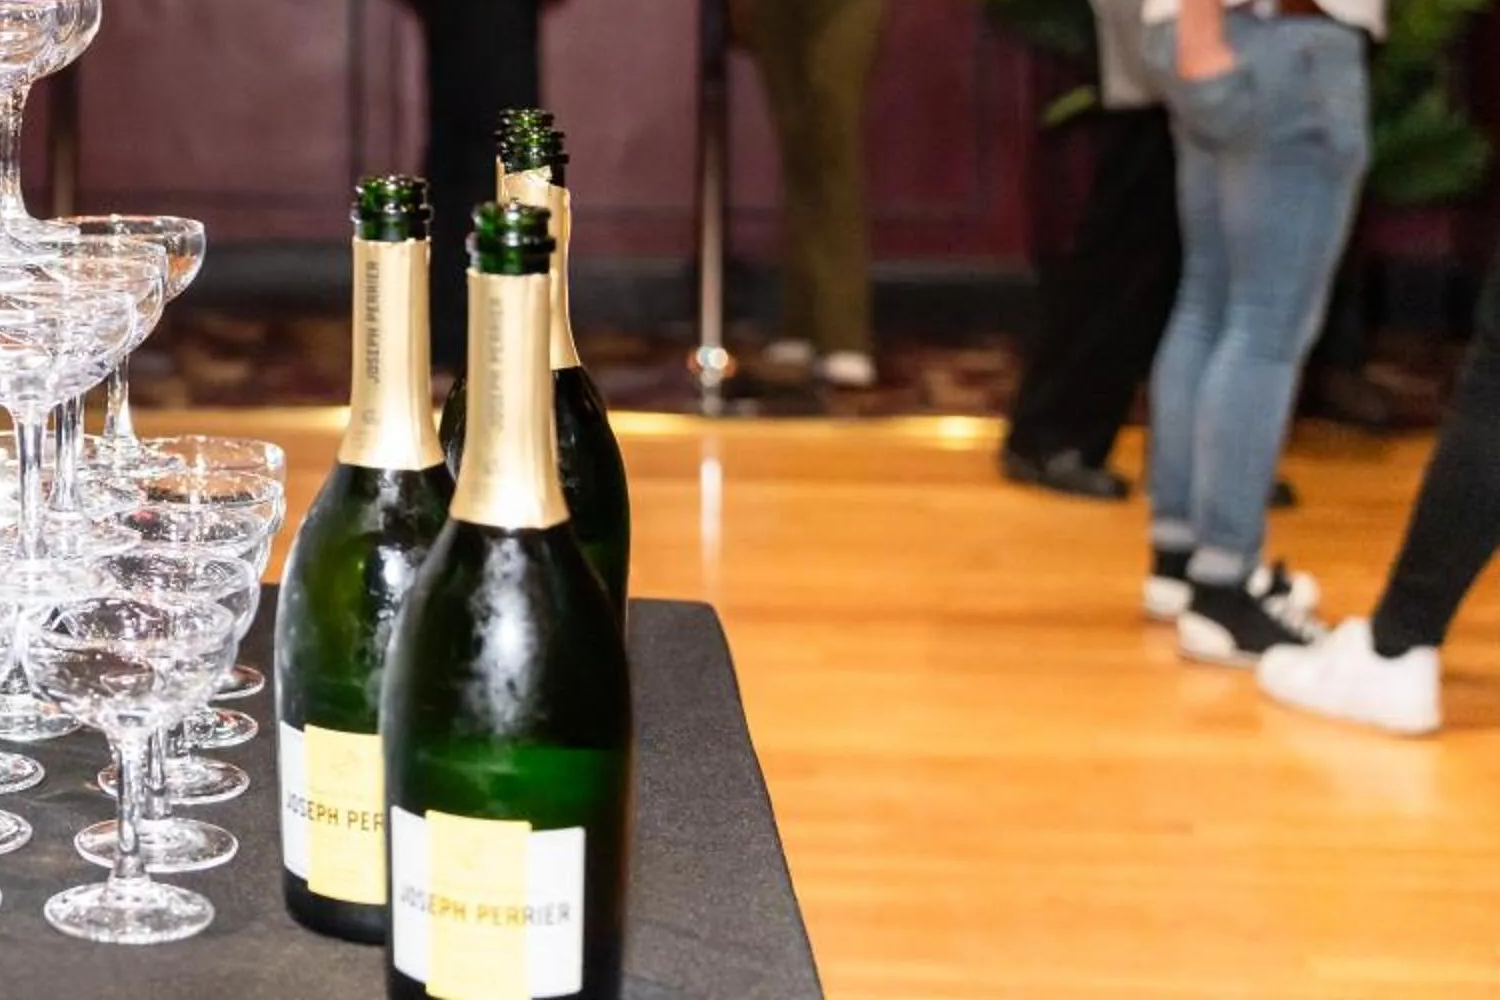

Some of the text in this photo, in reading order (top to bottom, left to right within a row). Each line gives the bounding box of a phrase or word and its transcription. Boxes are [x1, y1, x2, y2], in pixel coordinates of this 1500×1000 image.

[365, 260, 380, 385] JOSEPH PERRIER
[286, 792, 340, 826] JOSEPH
[401, 886, 571, 926] JOSEPH PERRIER
